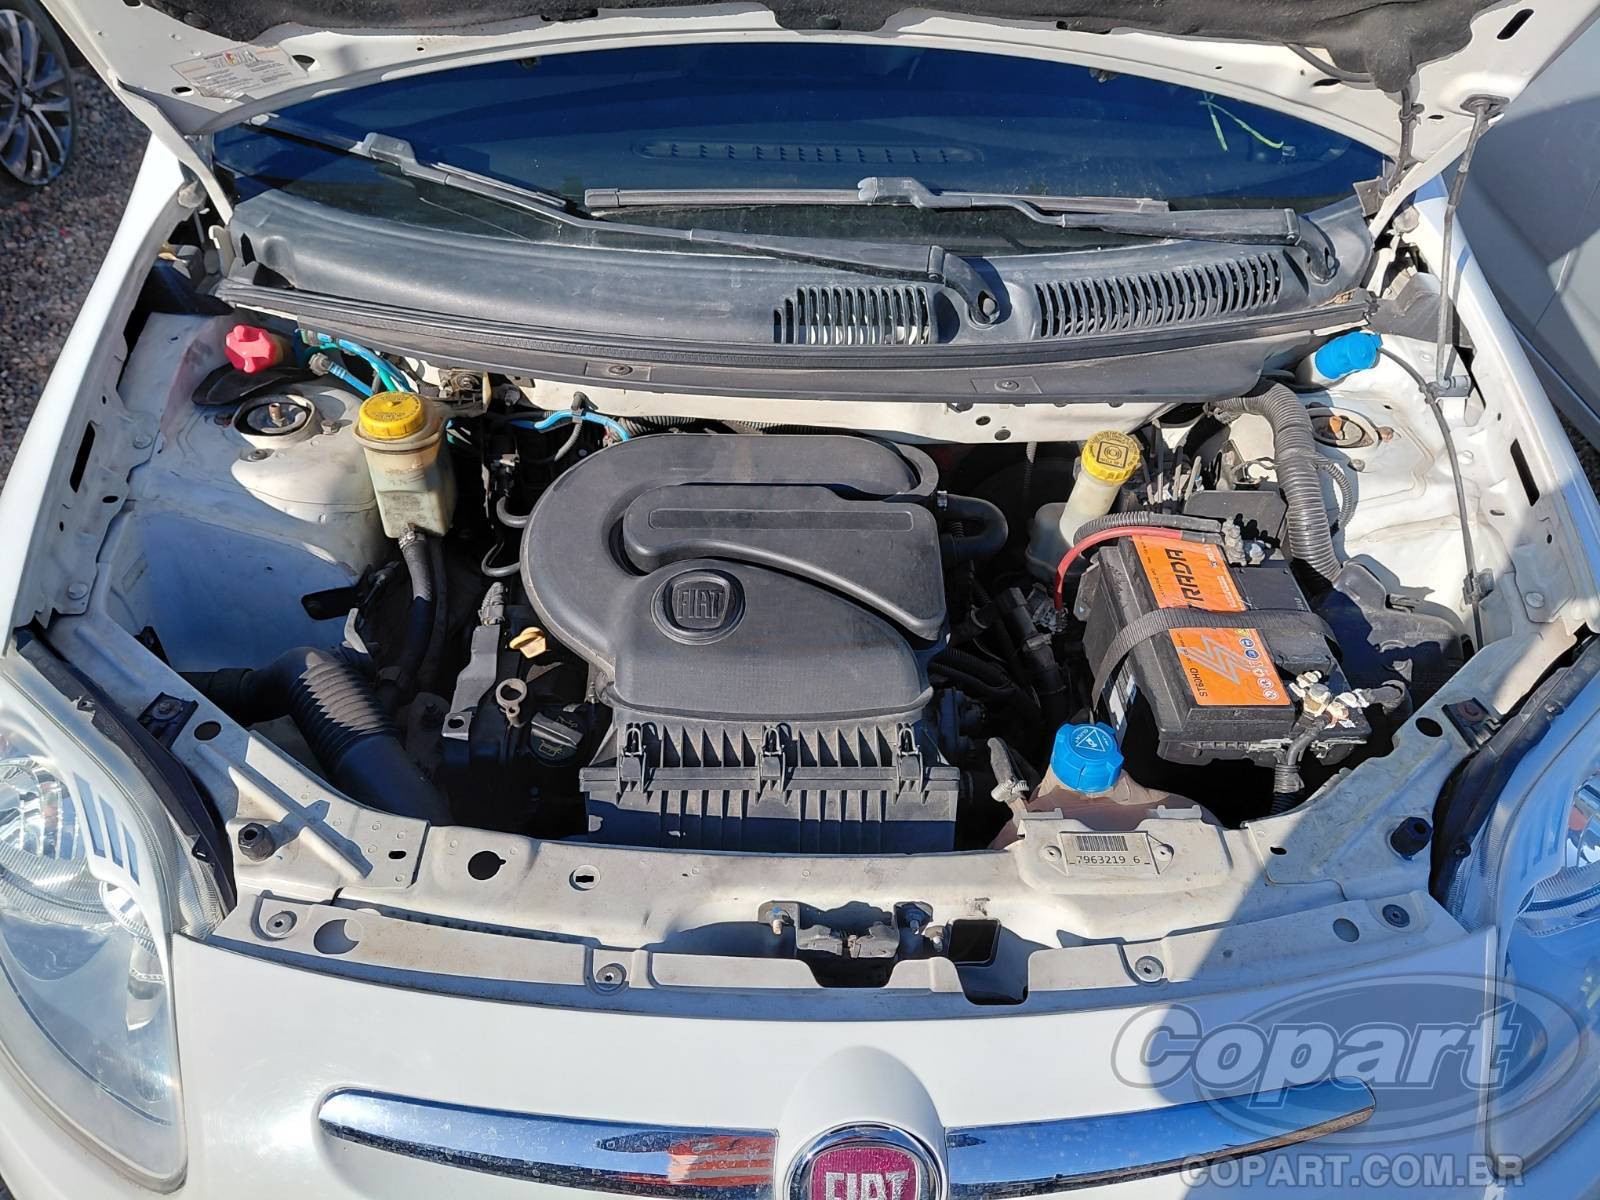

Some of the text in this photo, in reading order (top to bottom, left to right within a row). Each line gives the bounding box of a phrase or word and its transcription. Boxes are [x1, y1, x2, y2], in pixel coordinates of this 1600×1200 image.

[1164, 548, 1204, 602] RADA
[676, 588, 723, 619] FIAT
[1076, 854, 1141, 865] 7963219 6
[824, 1168, 910, 1200] FIAT
